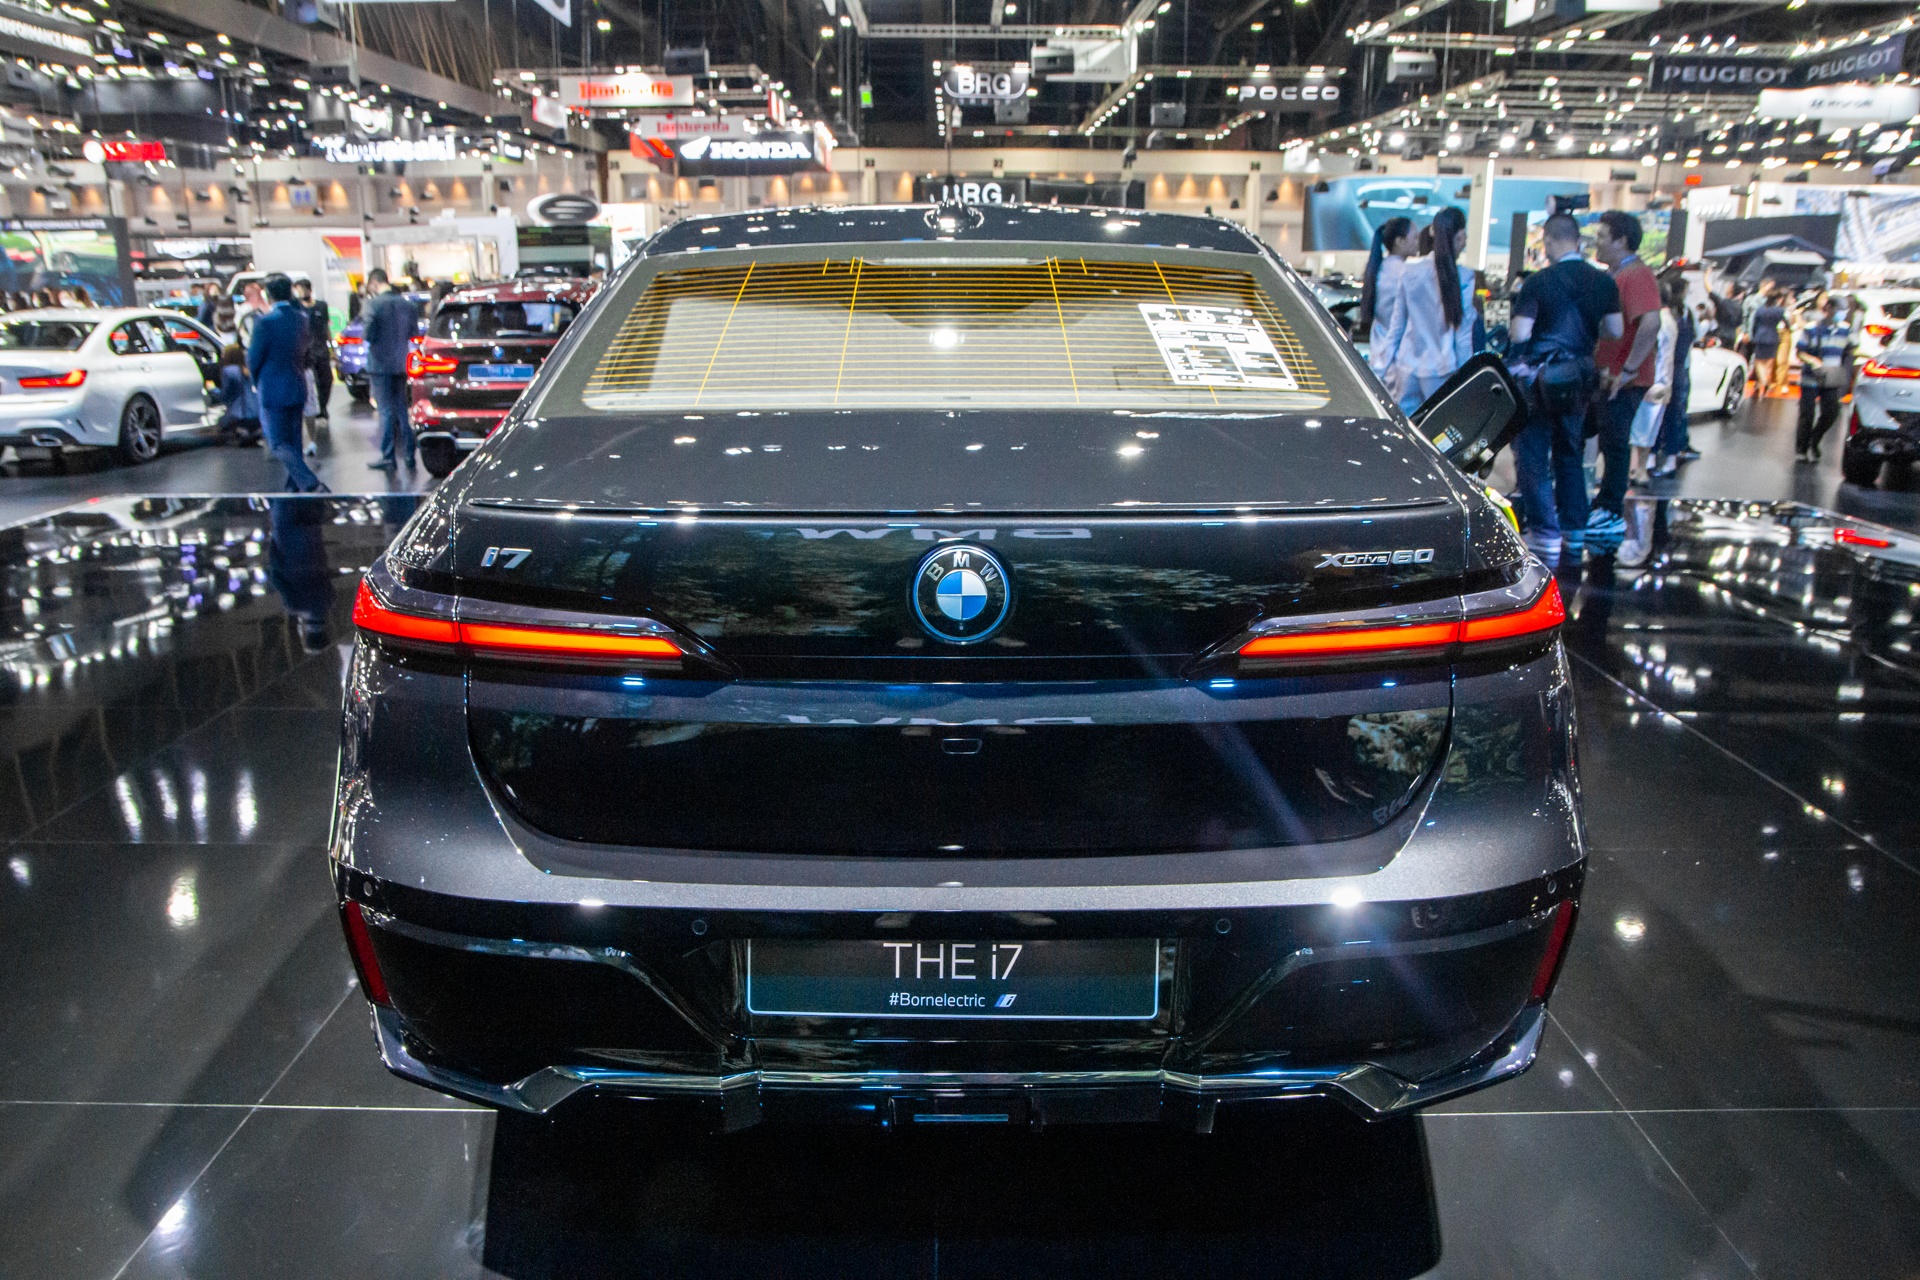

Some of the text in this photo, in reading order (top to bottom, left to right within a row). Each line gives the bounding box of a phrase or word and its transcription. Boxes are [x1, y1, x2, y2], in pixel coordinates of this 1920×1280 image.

[1806, 46, 1896, 82] PEUGEOT
[958, 71, 1011, 96] BRG
[1663, 65, 1793, 85] PEUGEOT
[579, 81, 674, 100] lambtta
[1239, 85, 1340, 102] POCCO
[656, 122, 730, 133] lambretta
[710, 141, 812, 159] HONDA
[480, 546, 533, 569] i7
[926, 551, 999, 582] BMW
[883, 942, 1023, 980] THE i7
[888, 992, 986, 1008] #Bornelectric
